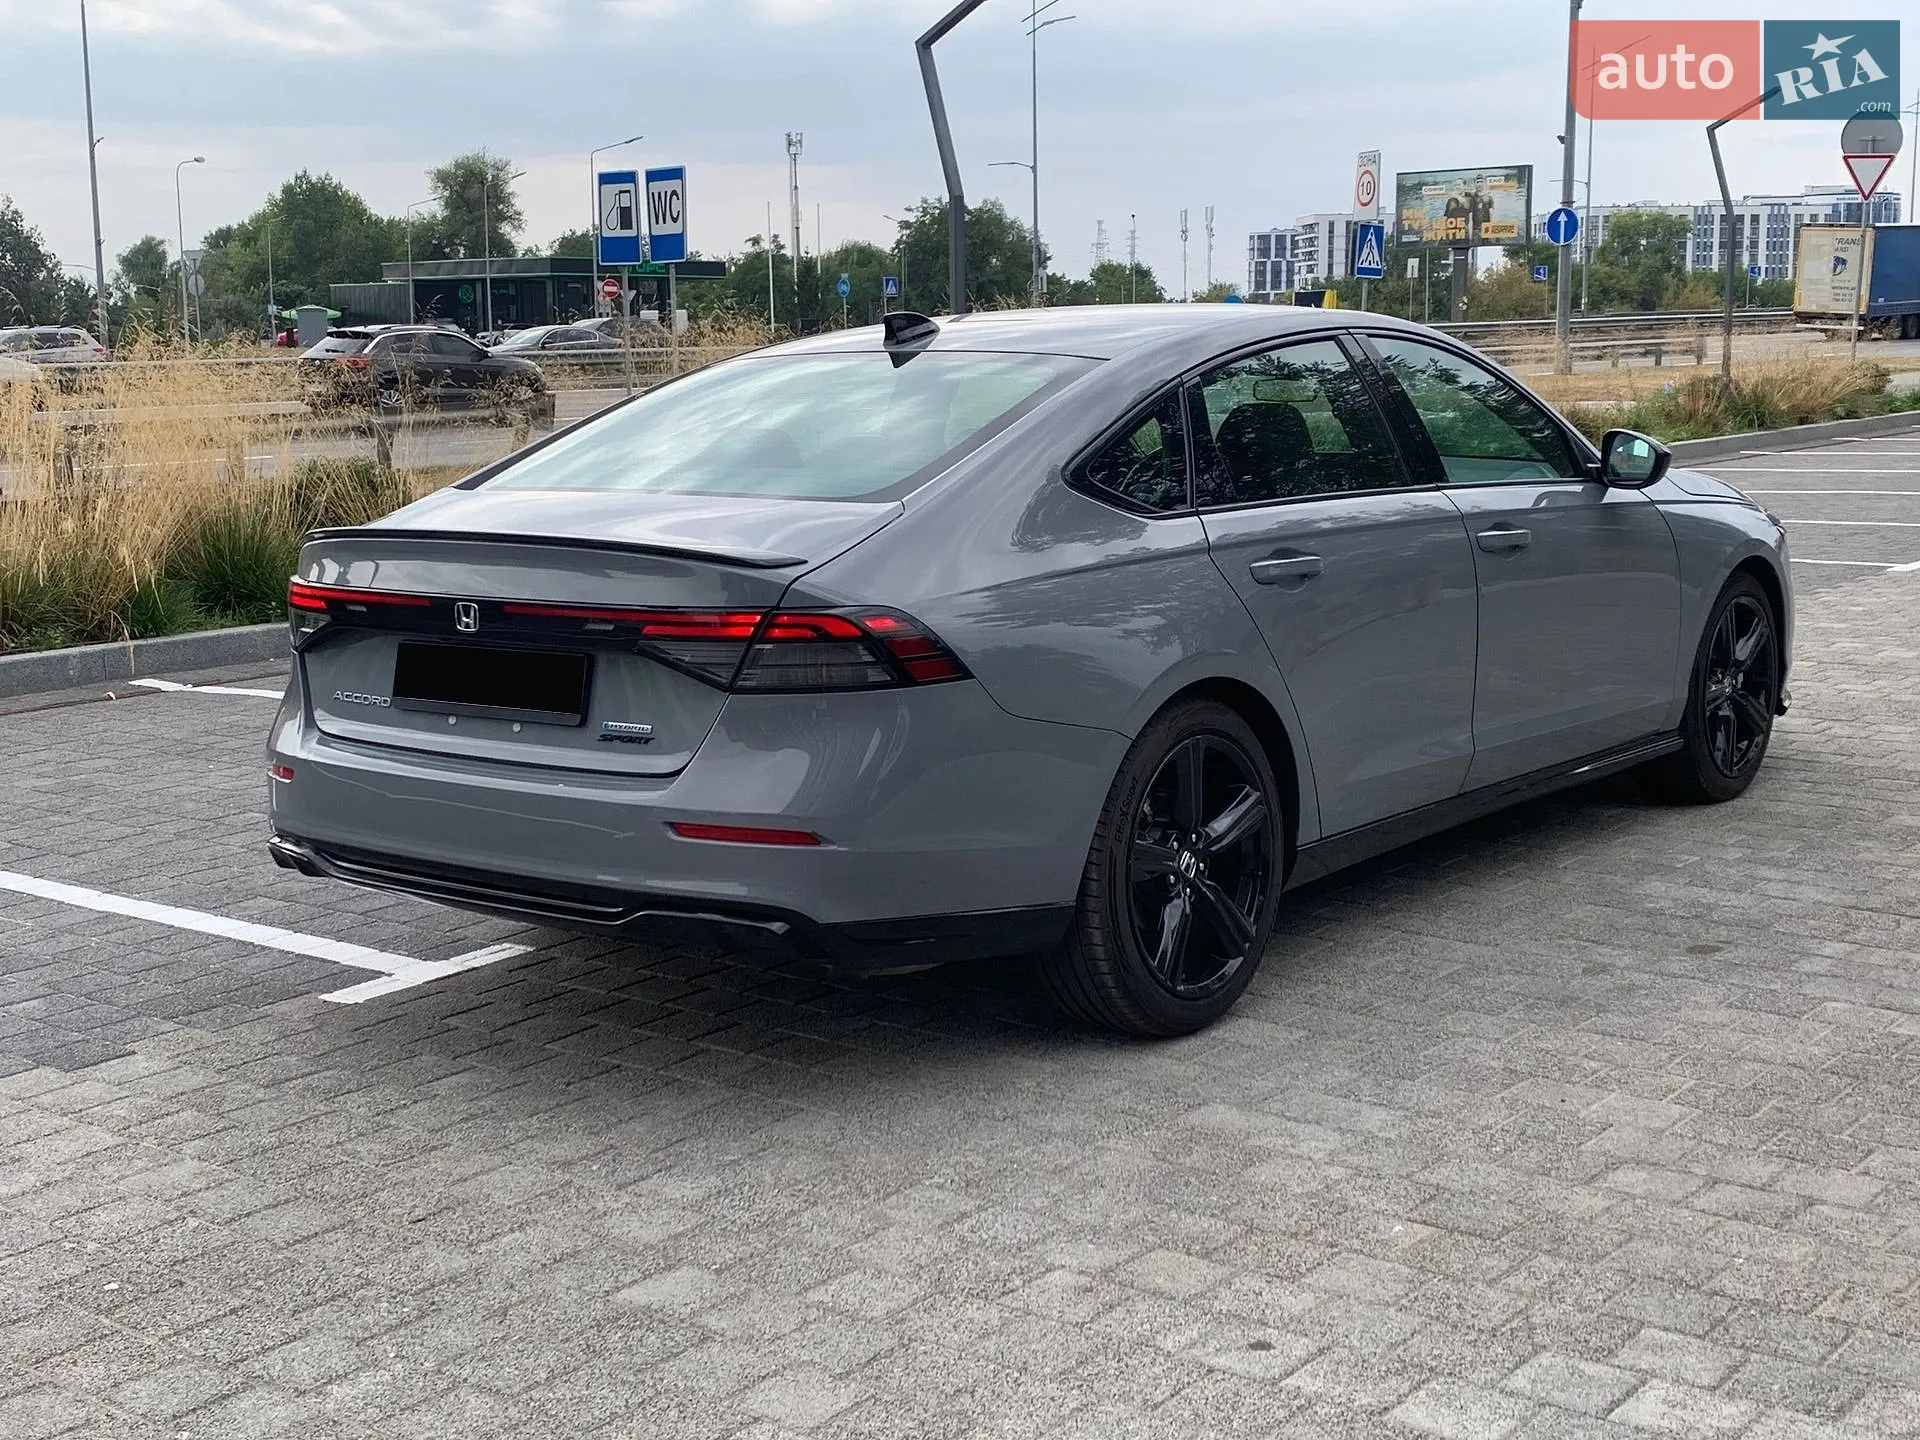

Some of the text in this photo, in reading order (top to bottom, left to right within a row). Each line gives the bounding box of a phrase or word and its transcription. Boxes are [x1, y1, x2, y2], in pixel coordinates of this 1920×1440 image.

[1359, 154, 1377, 167] ЗОНА
[1360, 181, 1371, 196] 10
[651, 189, 681, 225] WC
[332, 690, 391, 707] ACCORD
[609, 722, 650, 732] HYBRID
[597, 733, 655, 745] SPORT
